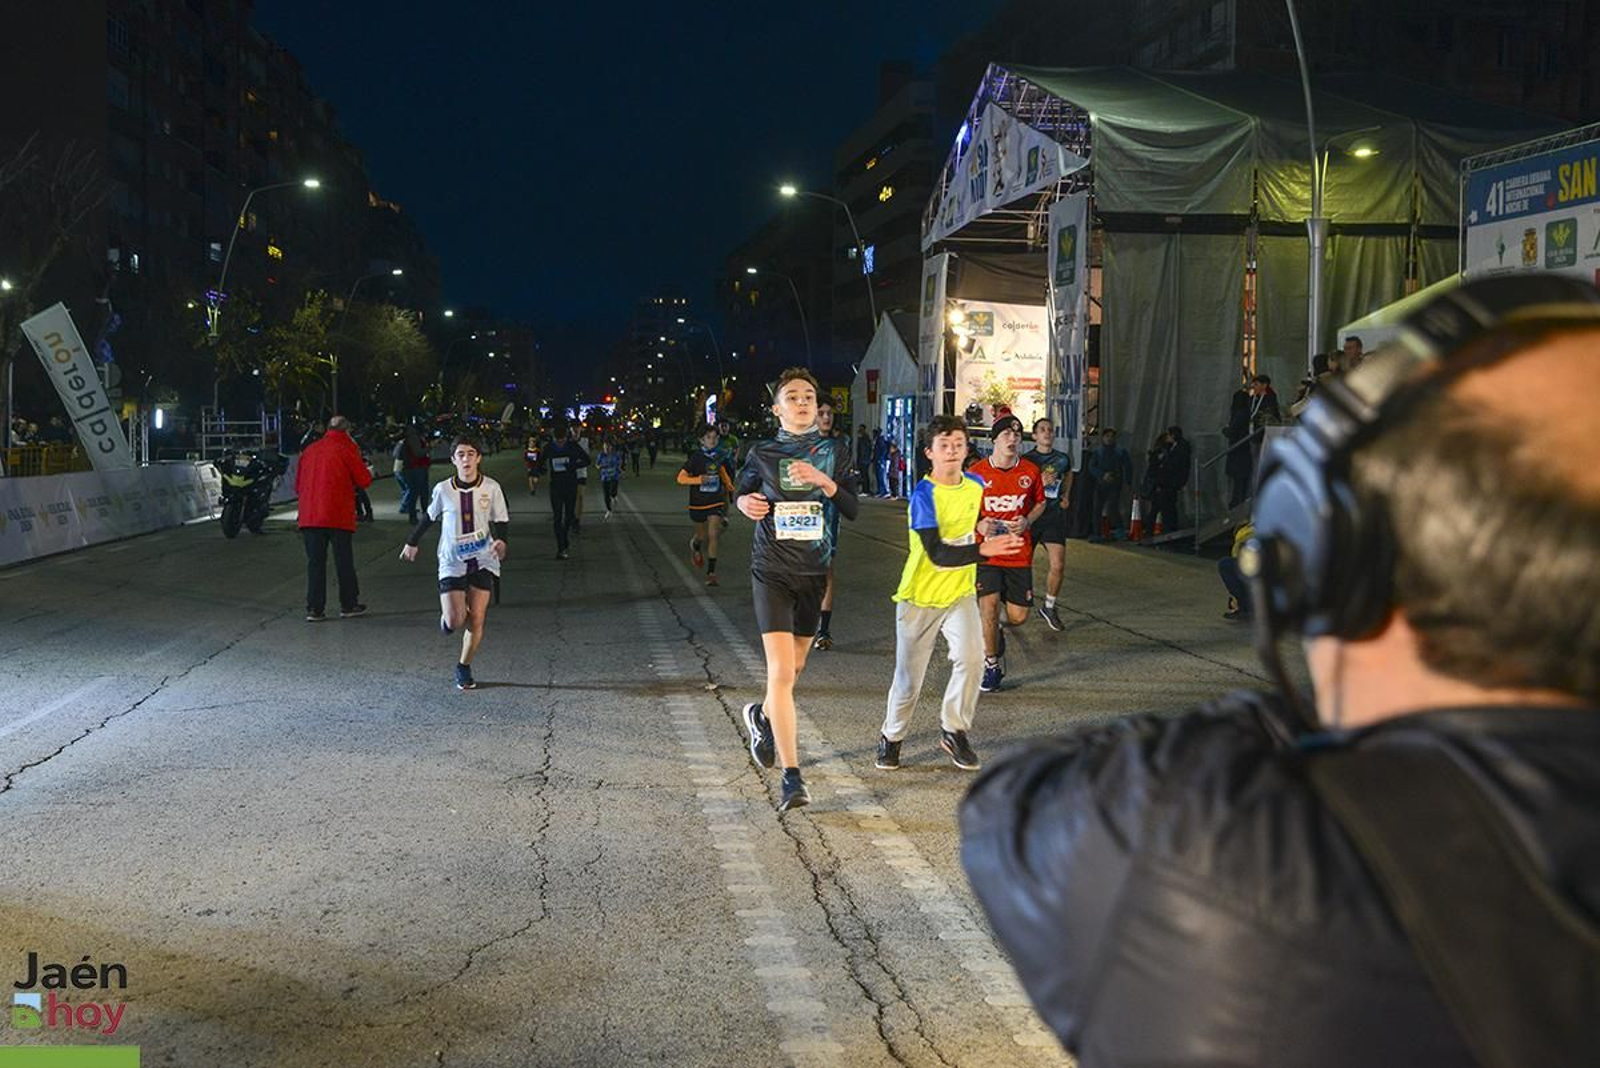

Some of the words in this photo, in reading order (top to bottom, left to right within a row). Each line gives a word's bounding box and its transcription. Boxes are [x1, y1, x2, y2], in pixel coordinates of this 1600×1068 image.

[1557, 156, 1598, 203] SAN
[1485, 180, 1505, 217] 41
[984, 494, 1027, 512] RSK
